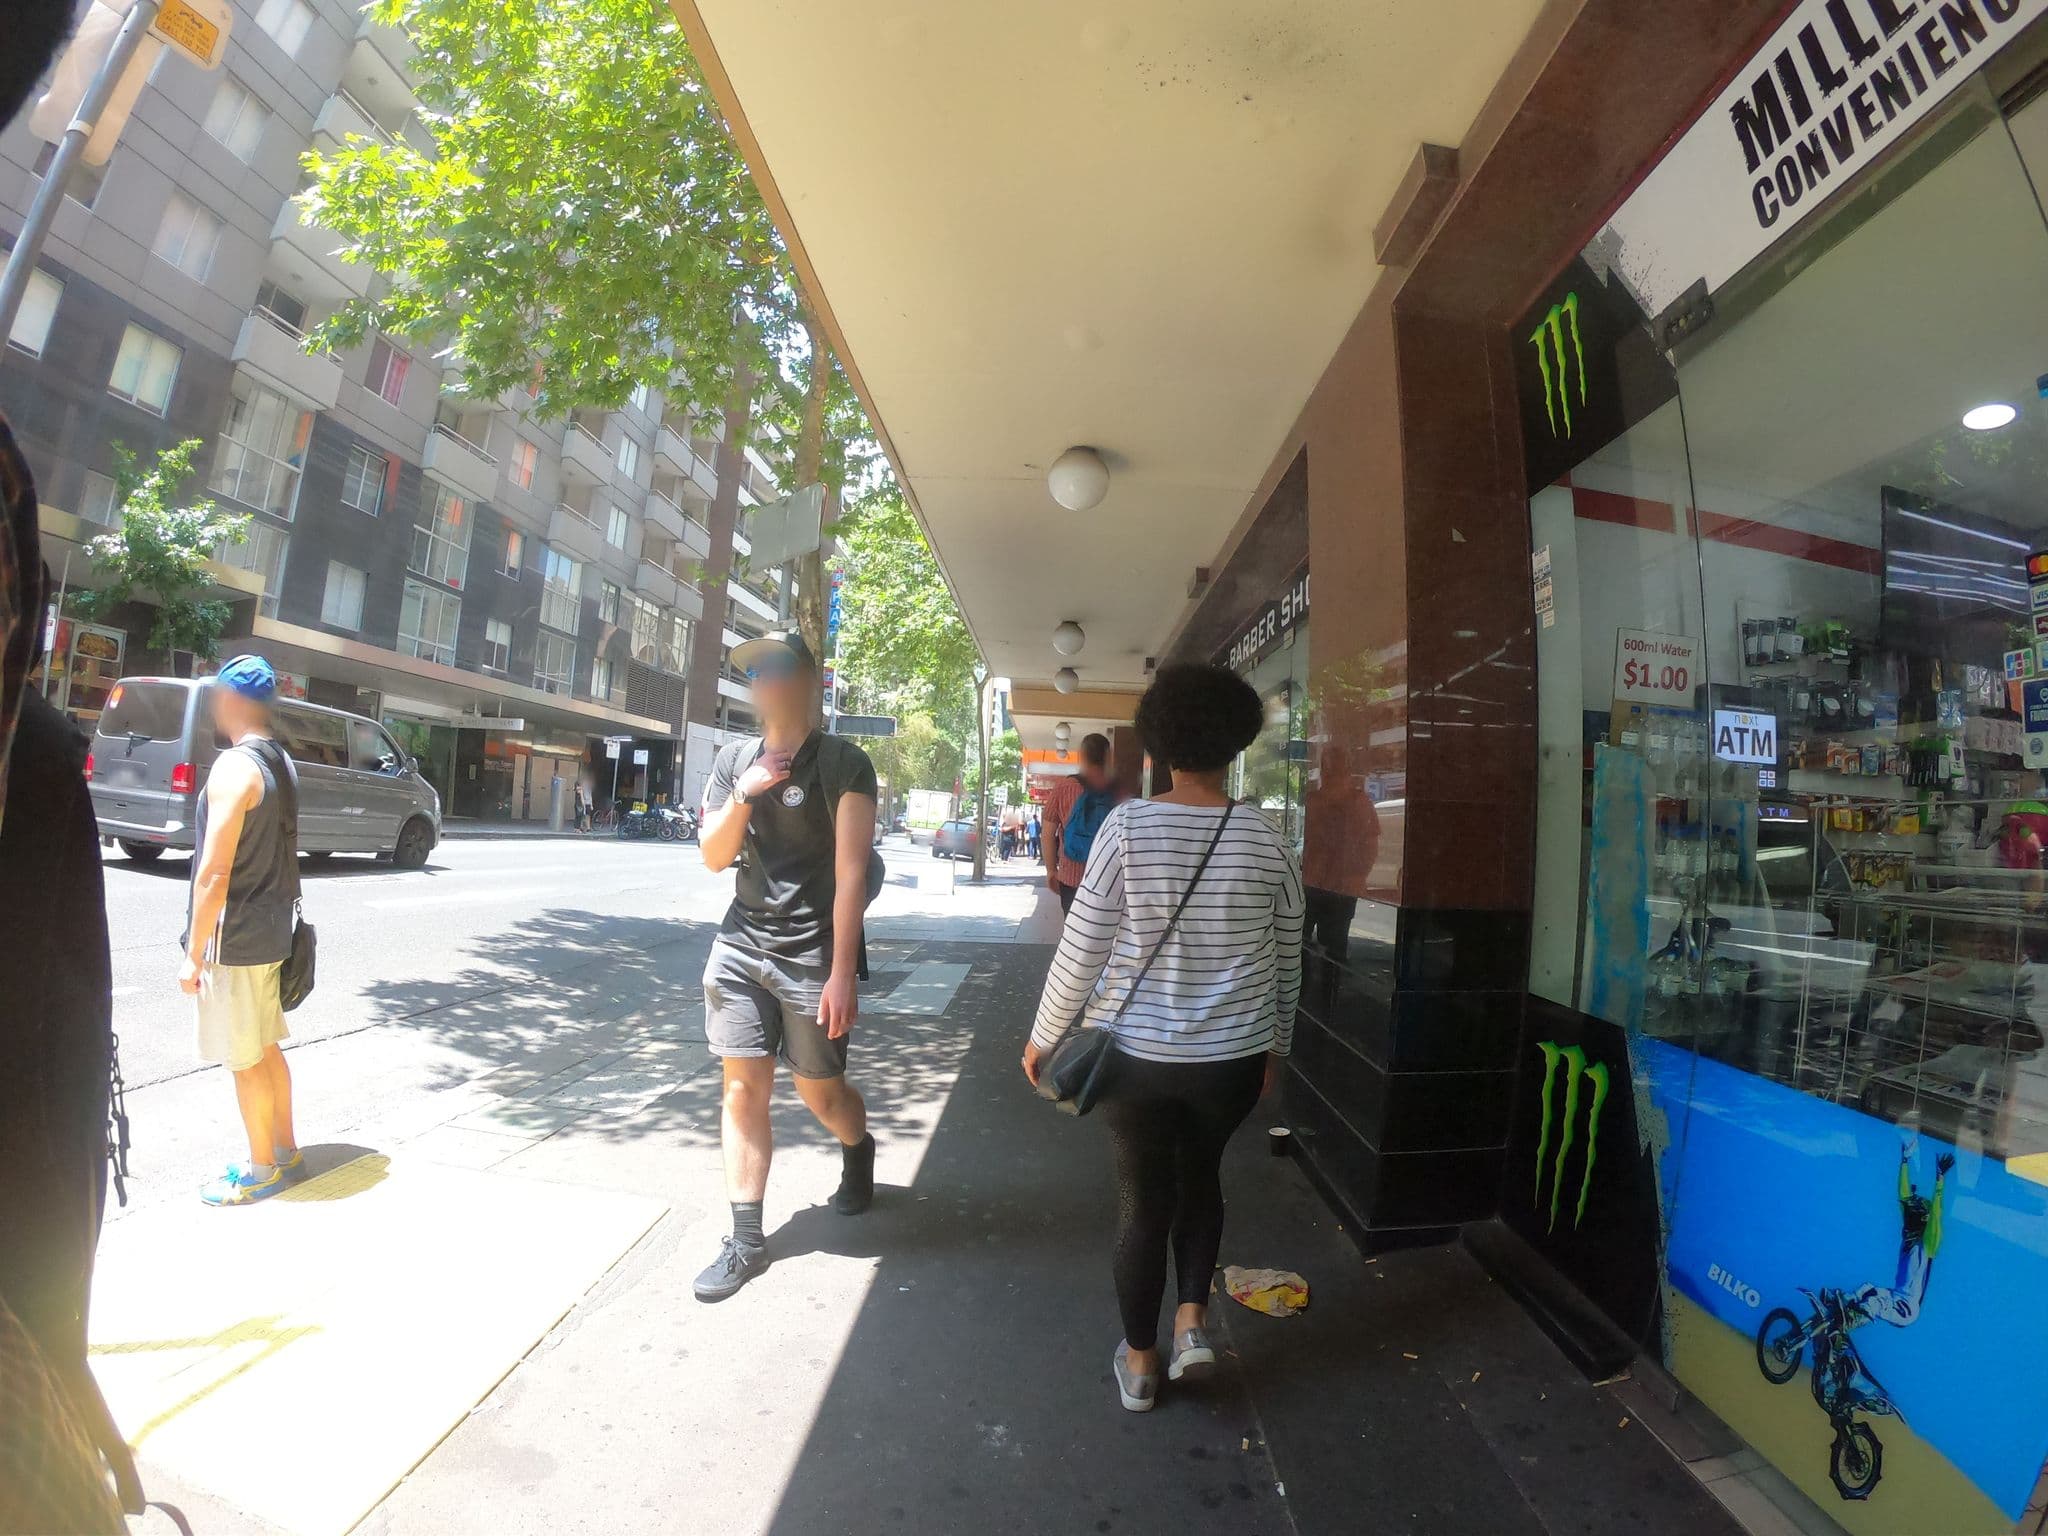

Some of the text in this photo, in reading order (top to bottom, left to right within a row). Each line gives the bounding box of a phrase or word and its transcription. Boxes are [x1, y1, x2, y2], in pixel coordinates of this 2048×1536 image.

[1229, 609, 1275, 670] BARBER
[1624, 639, 1692, 658] 600ml Water
[1623, 658, 1688, 692] $1.00
[1717, 725, 1772, 757] ATM
[1707, 1263, 1760, 1308] BILKO
